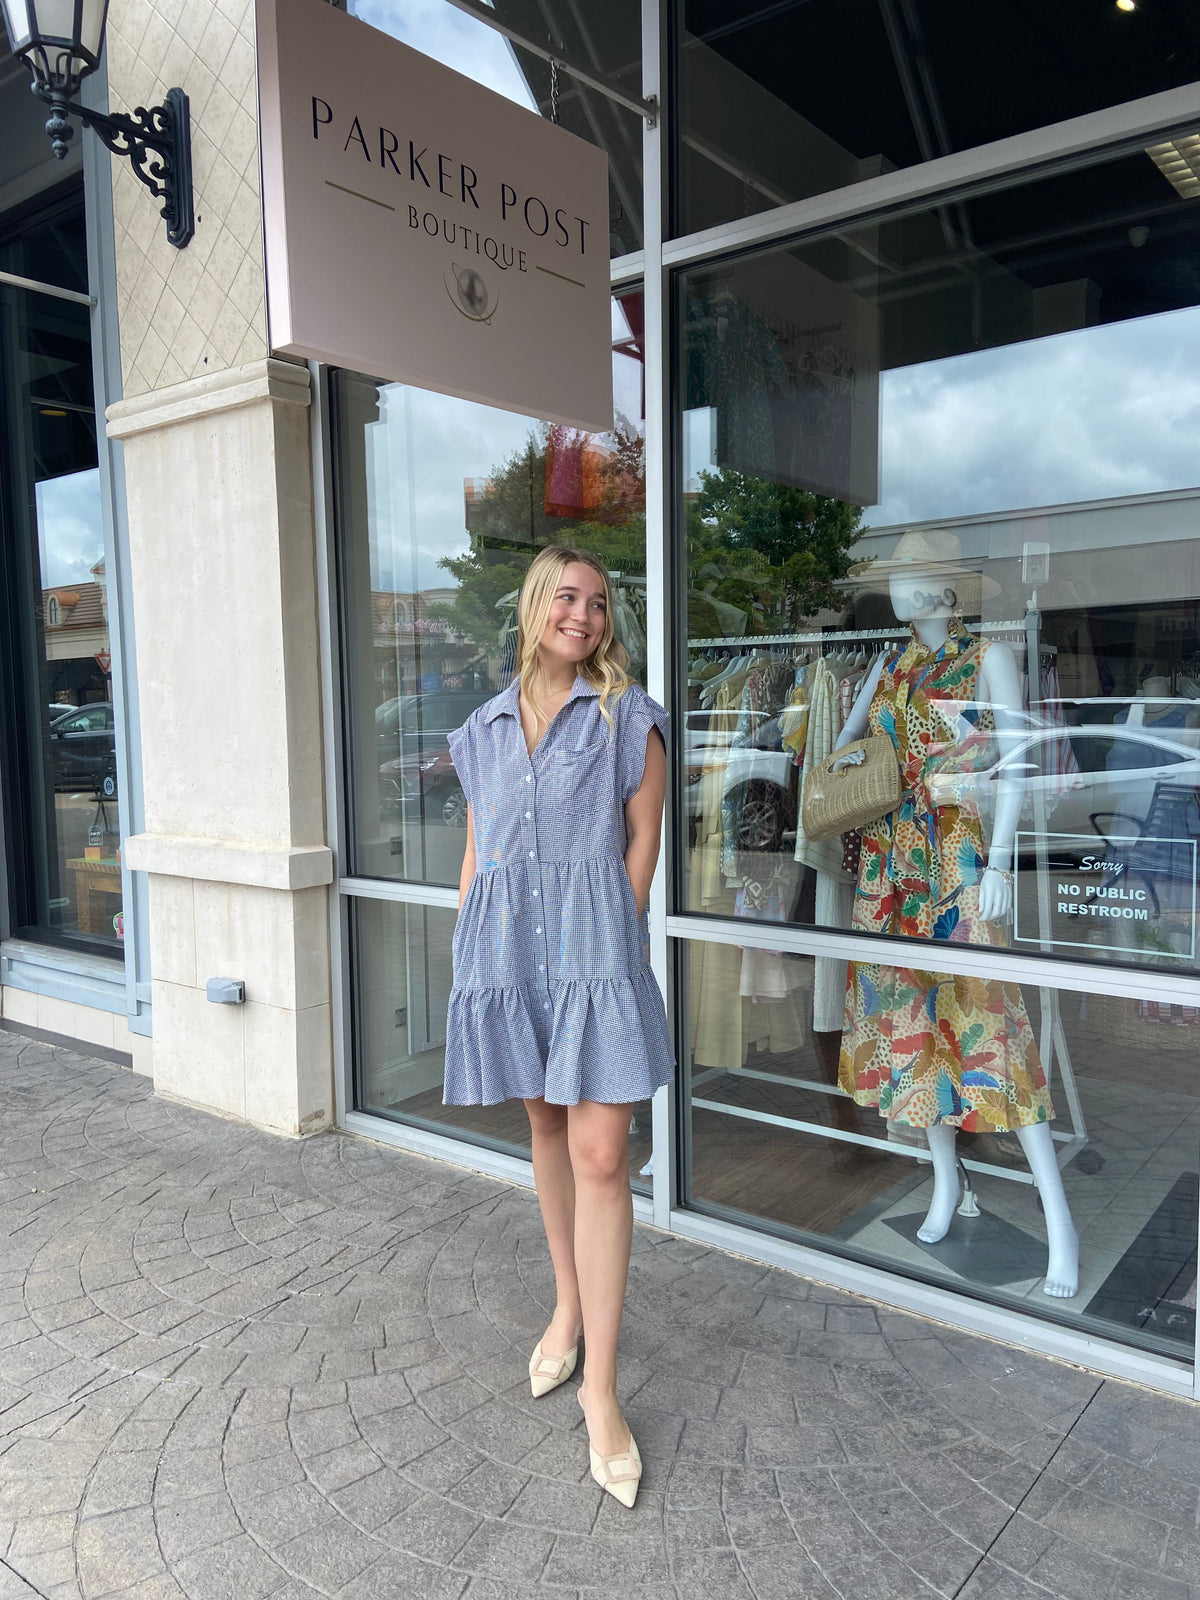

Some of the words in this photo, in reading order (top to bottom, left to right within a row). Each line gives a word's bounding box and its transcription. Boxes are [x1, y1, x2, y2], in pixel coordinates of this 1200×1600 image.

[311, 96, 480, 209] PARKER
[501, 183, 590, 255] POST
[407, 205, 528, 272] BOUTIQUE
[1078, 856, 1124, 875] Sorry
[1057, 884, 1081, 895] NO
[1086, 886, 1146, 900] PUBLIC
[1057, 903, 1148, 920] RESTROOM
